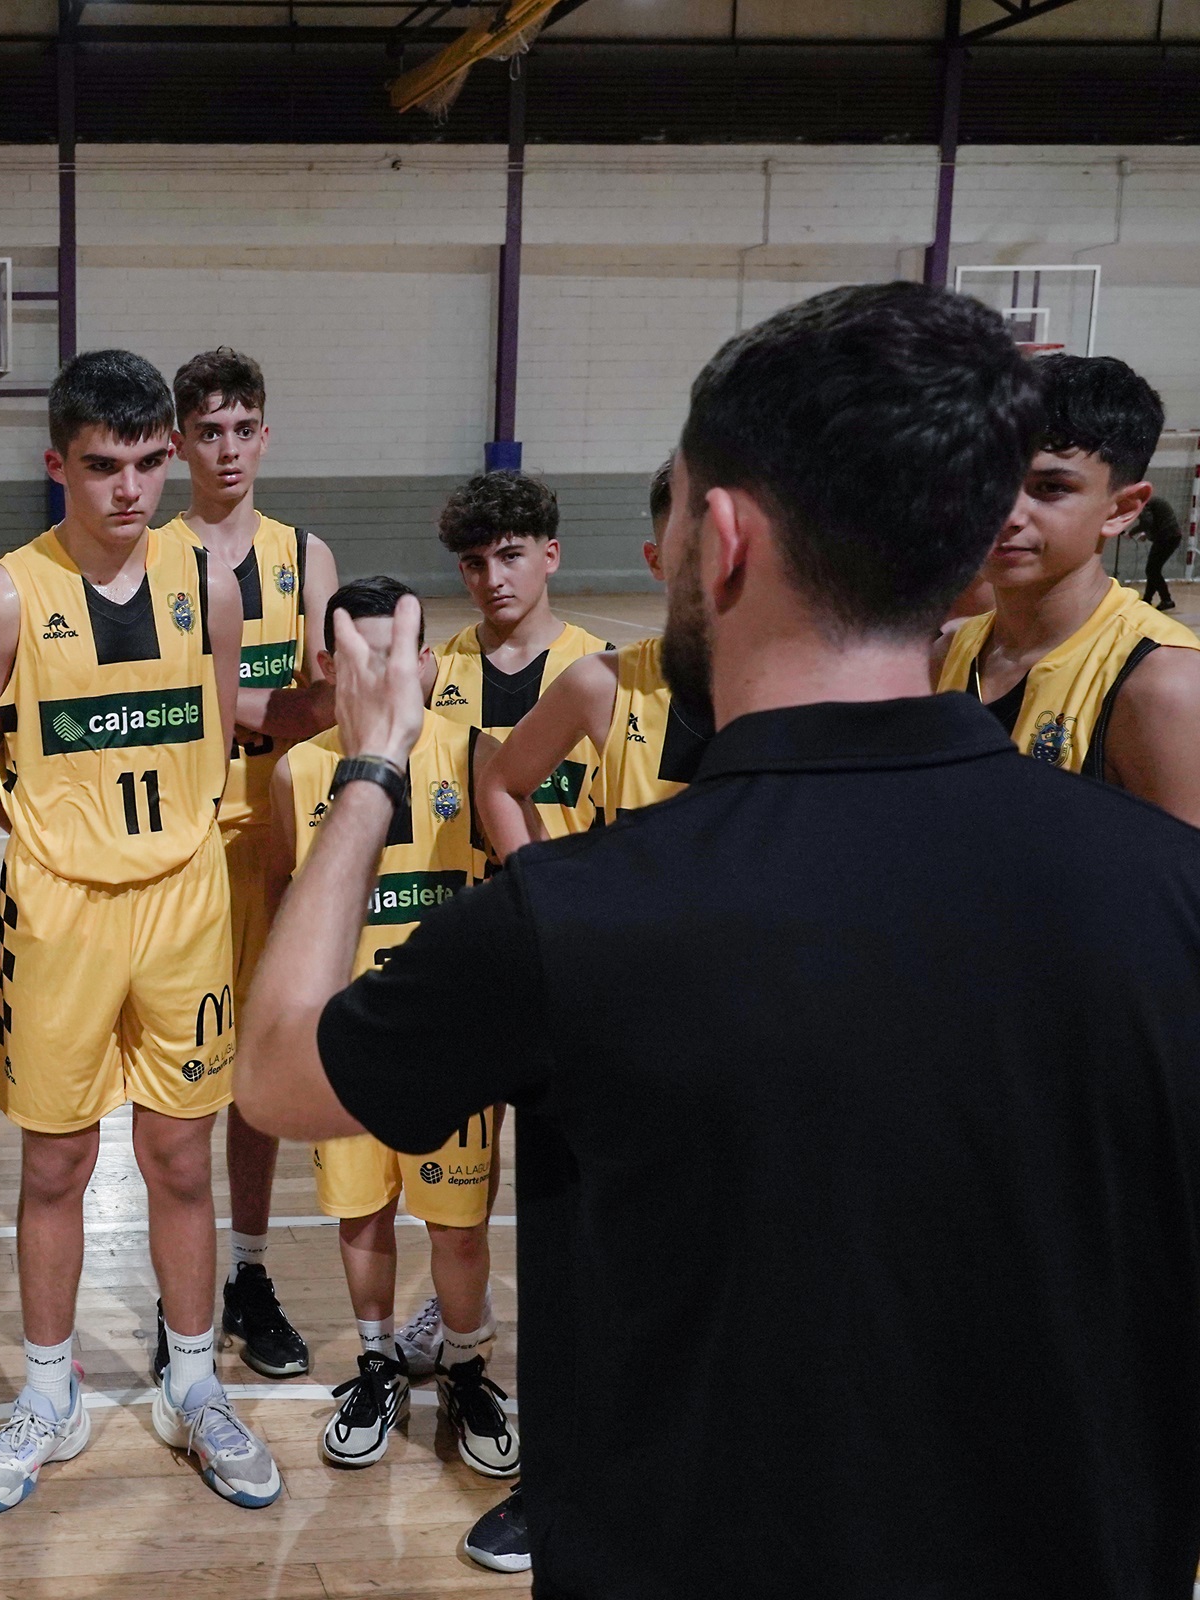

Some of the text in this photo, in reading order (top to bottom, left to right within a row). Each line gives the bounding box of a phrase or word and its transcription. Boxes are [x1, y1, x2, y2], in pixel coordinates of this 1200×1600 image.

[43, 630, 79, 640] austral
[435, 698, 469, 707] austral
[88, 701, 199, 736] cajasiete
[116, 769, 163, 836] 11
[448, 1164, 463, 1175] LA
